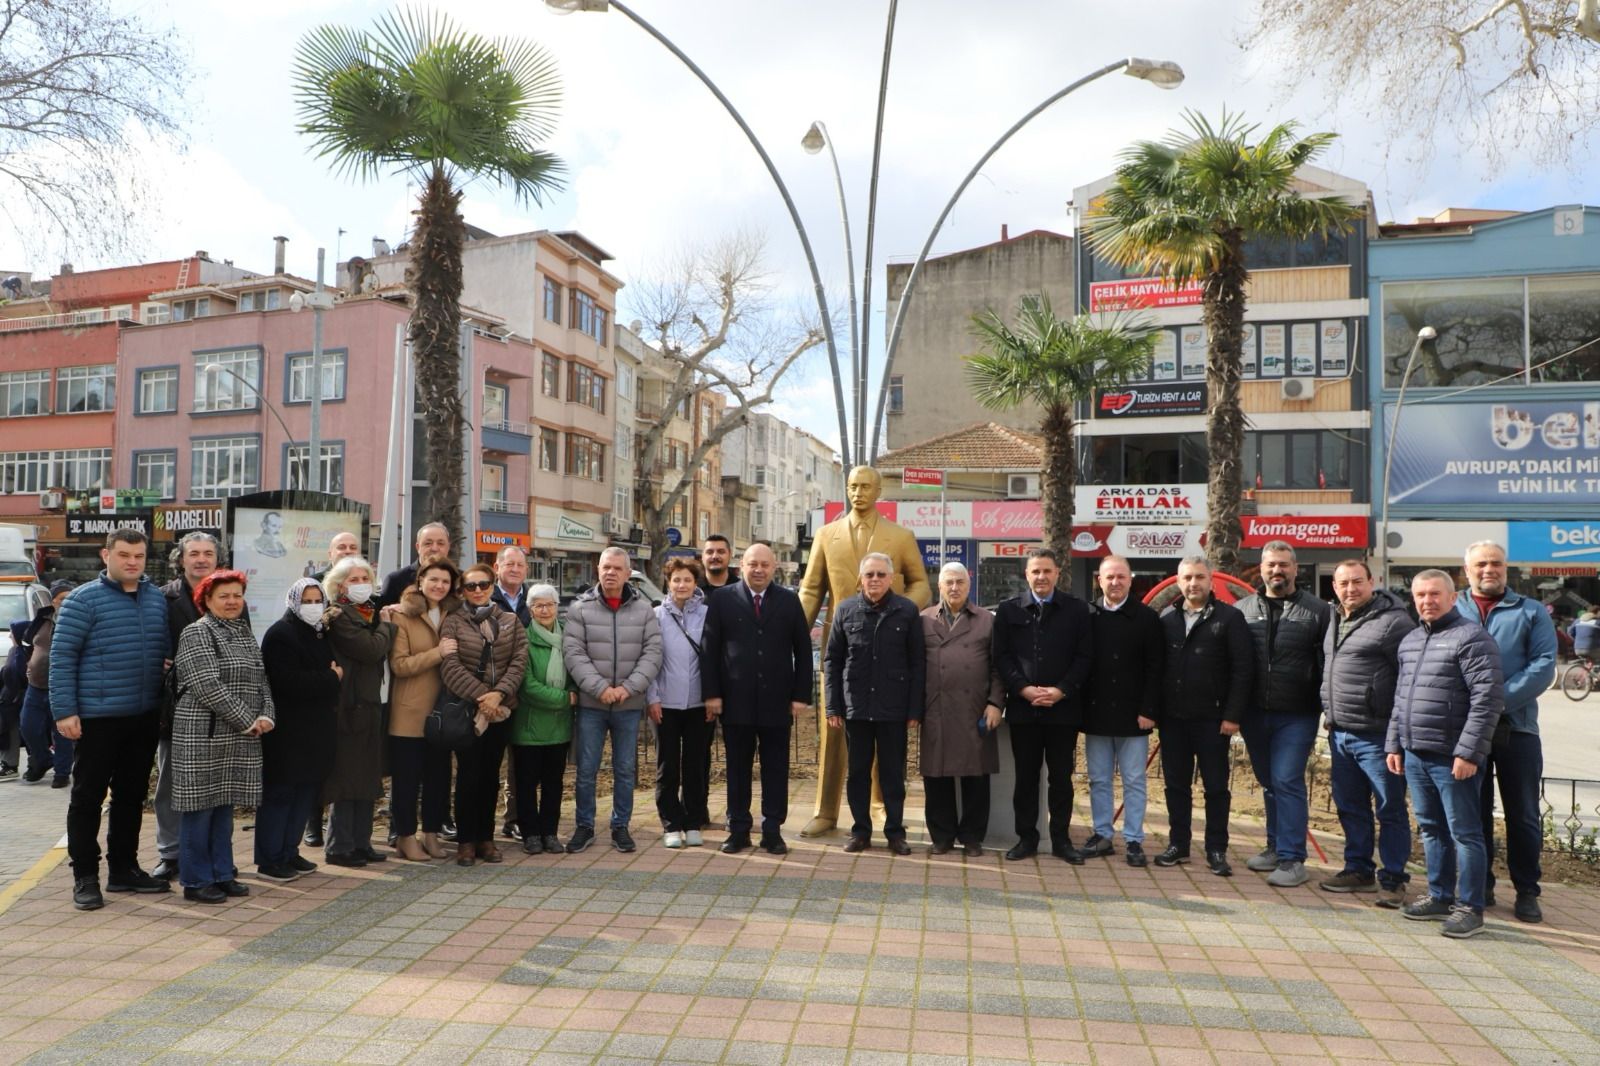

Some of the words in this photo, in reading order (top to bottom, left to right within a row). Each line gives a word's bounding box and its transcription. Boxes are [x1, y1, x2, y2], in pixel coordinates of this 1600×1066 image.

[1137, 391, 1160, 403] TURİZM
[1162, 391, 1180, 402] RENT
[1180, 393, 1186, 401] A
[1187, 391, 1201, 401] CAR
[1576, 457, 1600, 474] Mİ
[1498, 477, 1543, 493] EVİN
[1547, 477, 1577, 493] İLK
[1584, 479, 1600, 493] T
[1096, 496, 1192, 509] EMLAK
[84, 520, 116, 533] MARKA
[165, 509, 222, 530] BARGELLO
[1248, 519, 1340, 540] komagene
[1128, 533, 1183, 547] PALAZ
[926, 545, 963, 554] PHIIPS
